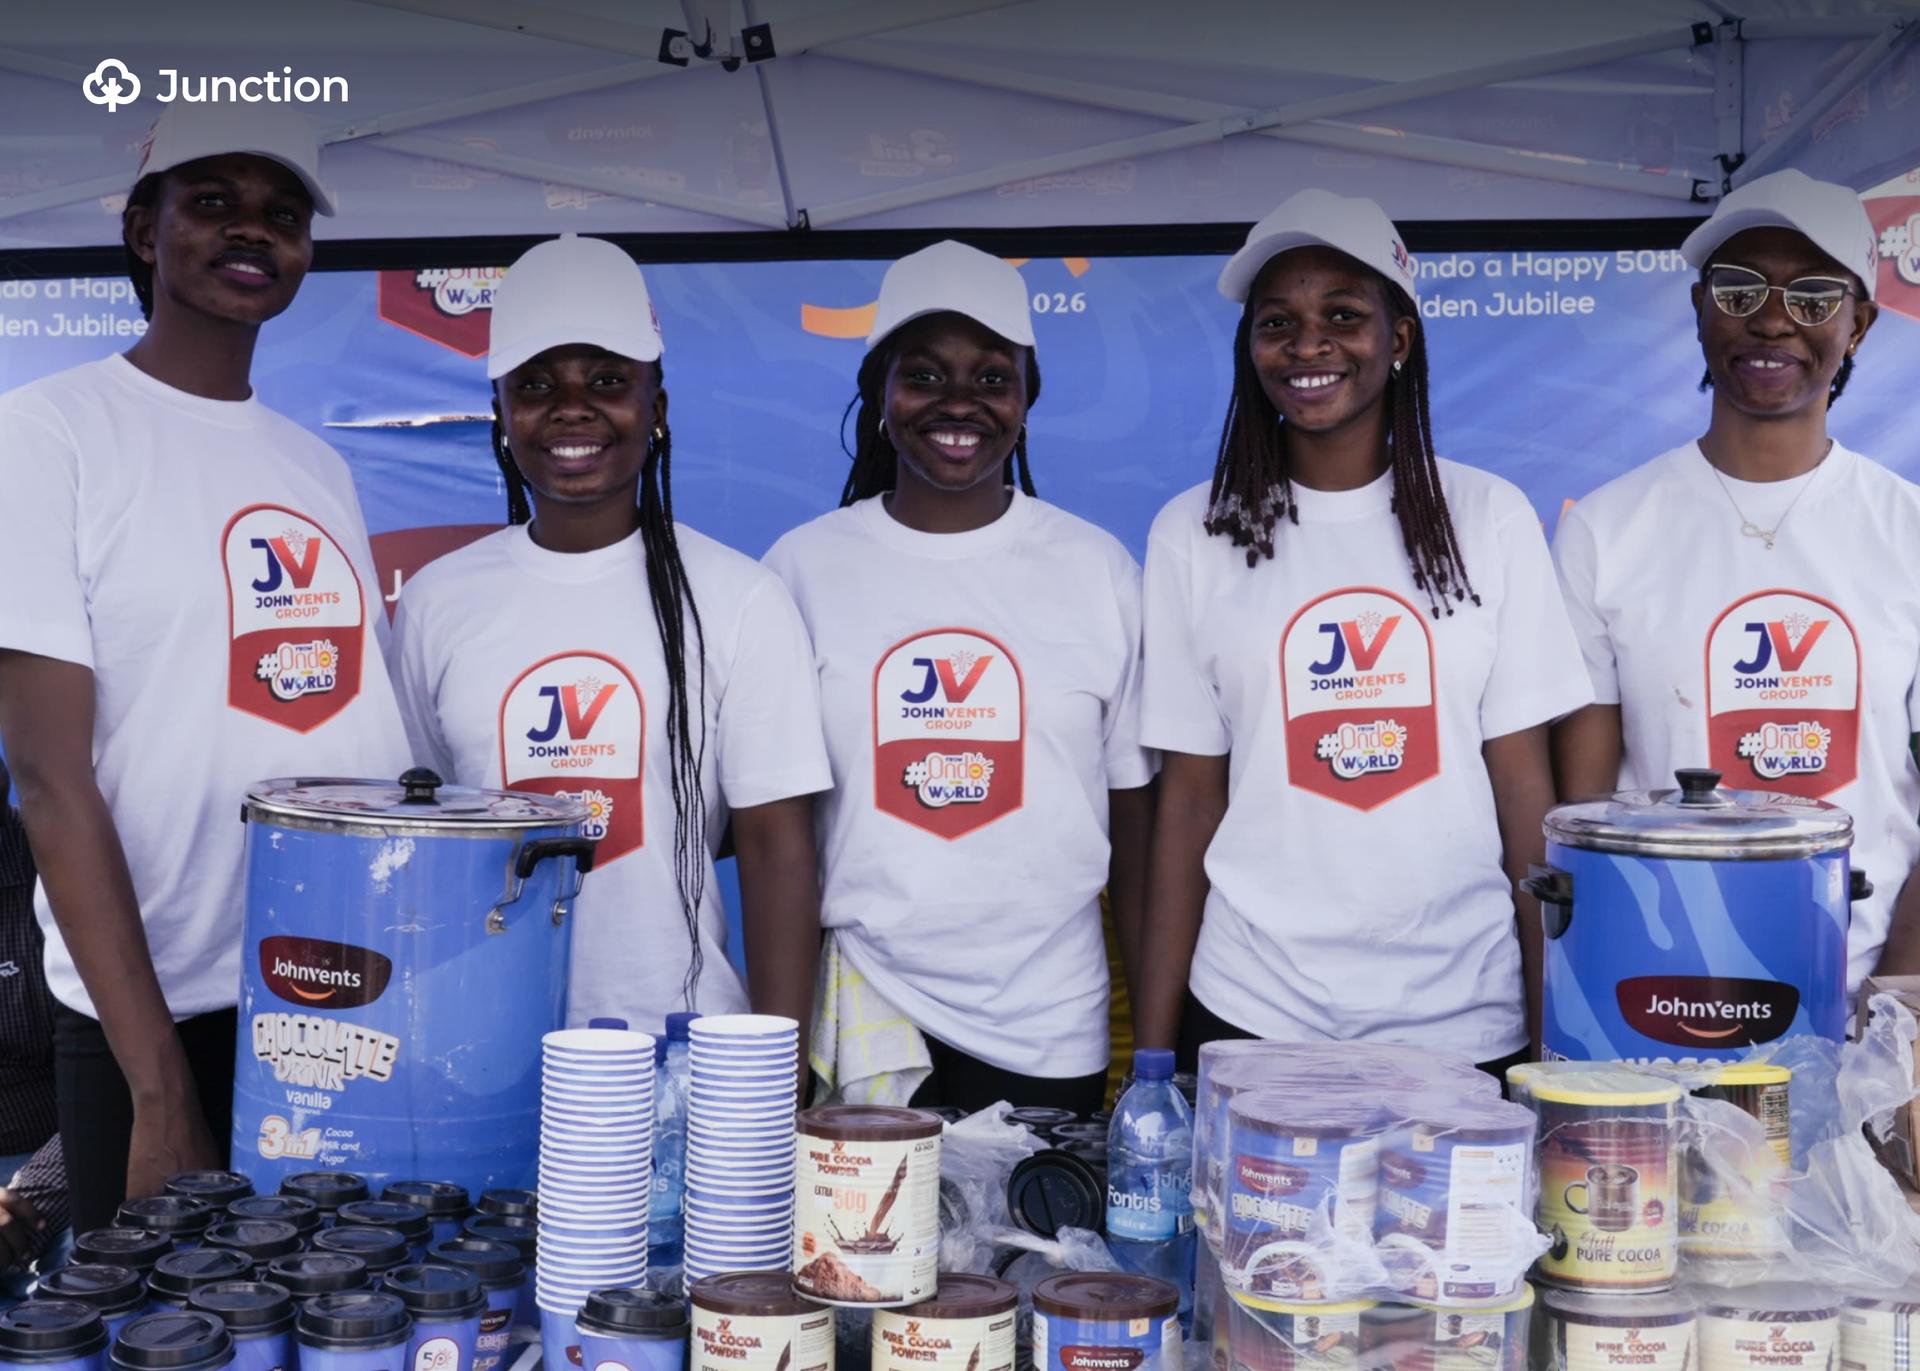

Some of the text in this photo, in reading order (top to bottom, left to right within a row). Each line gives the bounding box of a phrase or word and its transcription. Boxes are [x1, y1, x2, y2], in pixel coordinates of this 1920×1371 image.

[1484, 260, 1502, 277] a
[1512, 254, 1608, 281] Happy
[1616, 250, 1687, 273] 50th
[0, 278, 138, 304] do a Happ
[1033, 292, 1086, 313] 026
[1416, 292, 1595, 318] lden Jubilee
[46, 313, 149, 336] Jubilee
[250, 538, 321, 592] JV
[256, 592, 340, 609] JOHNVENTS
[276, 607, 319, 619] GROUP
[1308, 615, 1401, 675] JV
[1733, 620, 1830, 674] JV
[900, 655, 994, 704] JV
[1310, 673, 1406, 691] JOHNVENTS
[1735, 675, 1832, 689] JOHNVENTS
[1335, 689, 1382, 700] GROUP
[1759, 690, 1808, 700] GROUP
[526, 684, 619, 742] JV
[902, 707, 996, 719] JOHNVENTS
[925, 720, 972, 730] GROUP
[528, 744, 615, 757] JOHNVENTS
[551, 759, 593, 769] GROUP
[252, 1012, 399, 1082] CHOCOLATE
[275, 1059, 345, 1092] DRINK
[286, 1089, 332, 1110] vanilla
[258, 1115, 321, 1160] 3in1
[325, 1127, 354, 1138] Cocoa
[341, 1142, 360, 1151] and
[834, 1155, 872, 1166] COCOA
[817, 1164, 859, 1177] POWDER
[834, 1187, 866, 1213] 50g
[1577, 1247, 1661, 1262] PURE COCOA
[720, 1335, 762, 1348] COCOA
[908, 1337, 951, 1349] COCOA
[1628, 1343, 1667, 1352] COCOA
[1772, 1341, 1815, 1352] COCOA
[704, 1343, 747, 1359] POWDER
[891, 1346, 937, 1361] POWDER
[1609, 1354, 1656, 1364] POWDER
[1750, 1355, 1803, 1365] POWDER
